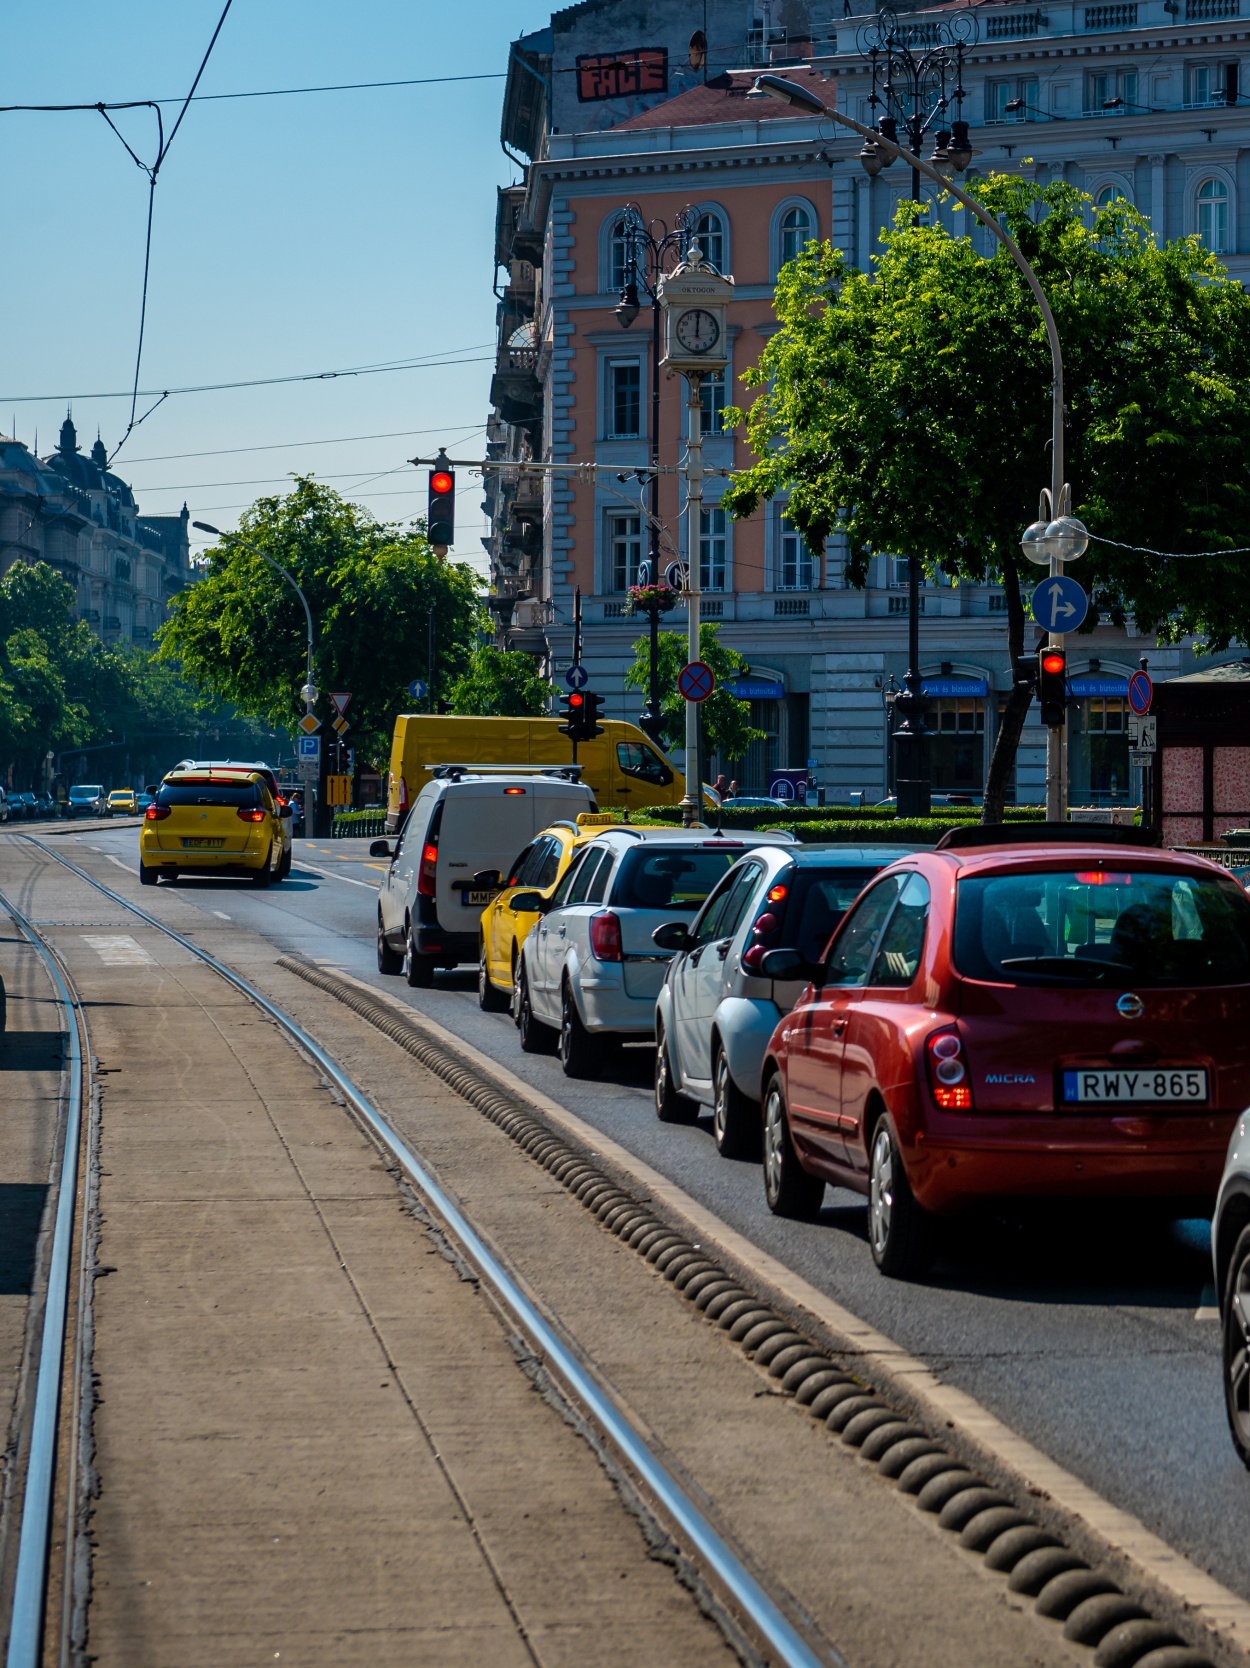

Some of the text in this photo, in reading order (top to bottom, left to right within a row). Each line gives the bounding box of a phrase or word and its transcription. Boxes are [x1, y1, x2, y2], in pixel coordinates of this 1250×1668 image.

[303, 740, 315, 753] P
[985, 1073, 1036, 1084] MICRA
[1084, 1073, 1200, 1098] RWY-865
